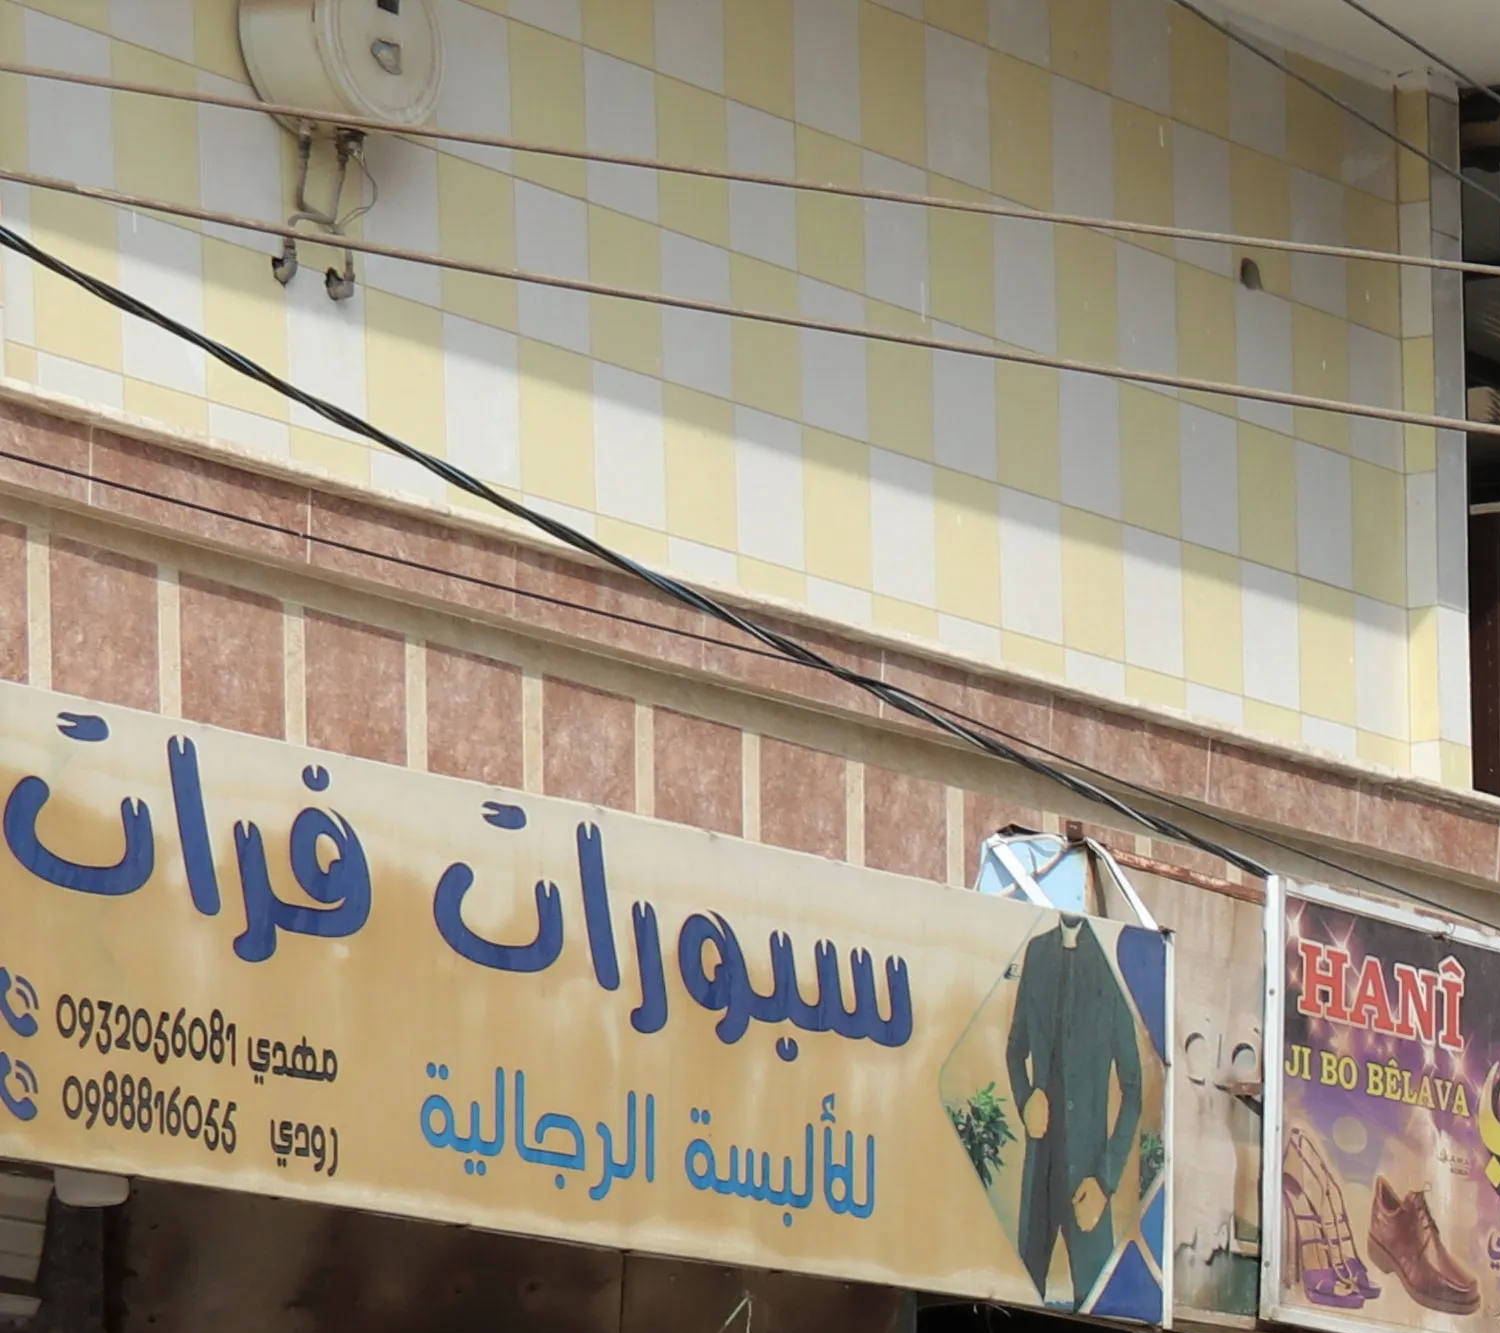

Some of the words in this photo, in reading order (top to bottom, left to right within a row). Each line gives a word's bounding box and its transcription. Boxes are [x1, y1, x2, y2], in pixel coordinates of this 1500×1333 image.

[3, 712, 372, 962] فرات
[433, 801, 913, 1062] سبورات
[56, 994, 237, 1067] 0932056081
[1298, 938, 1465, 1052] HANÎ
[248, 1036, 338, 1085] مهدي
[1285, 1044, 1312, 1080] JI
[1320, 1051, 1358, 1090] BO
[1366, 1058, 1471, 1117] BÊLAVA
[62, 1070, 237, 1154] 0988816055
[270, 1119, 338, 1176] رودي
[420, 1062, 655, 1201] الرجالية
[685, 1093, 875, 1227] للألبسة
